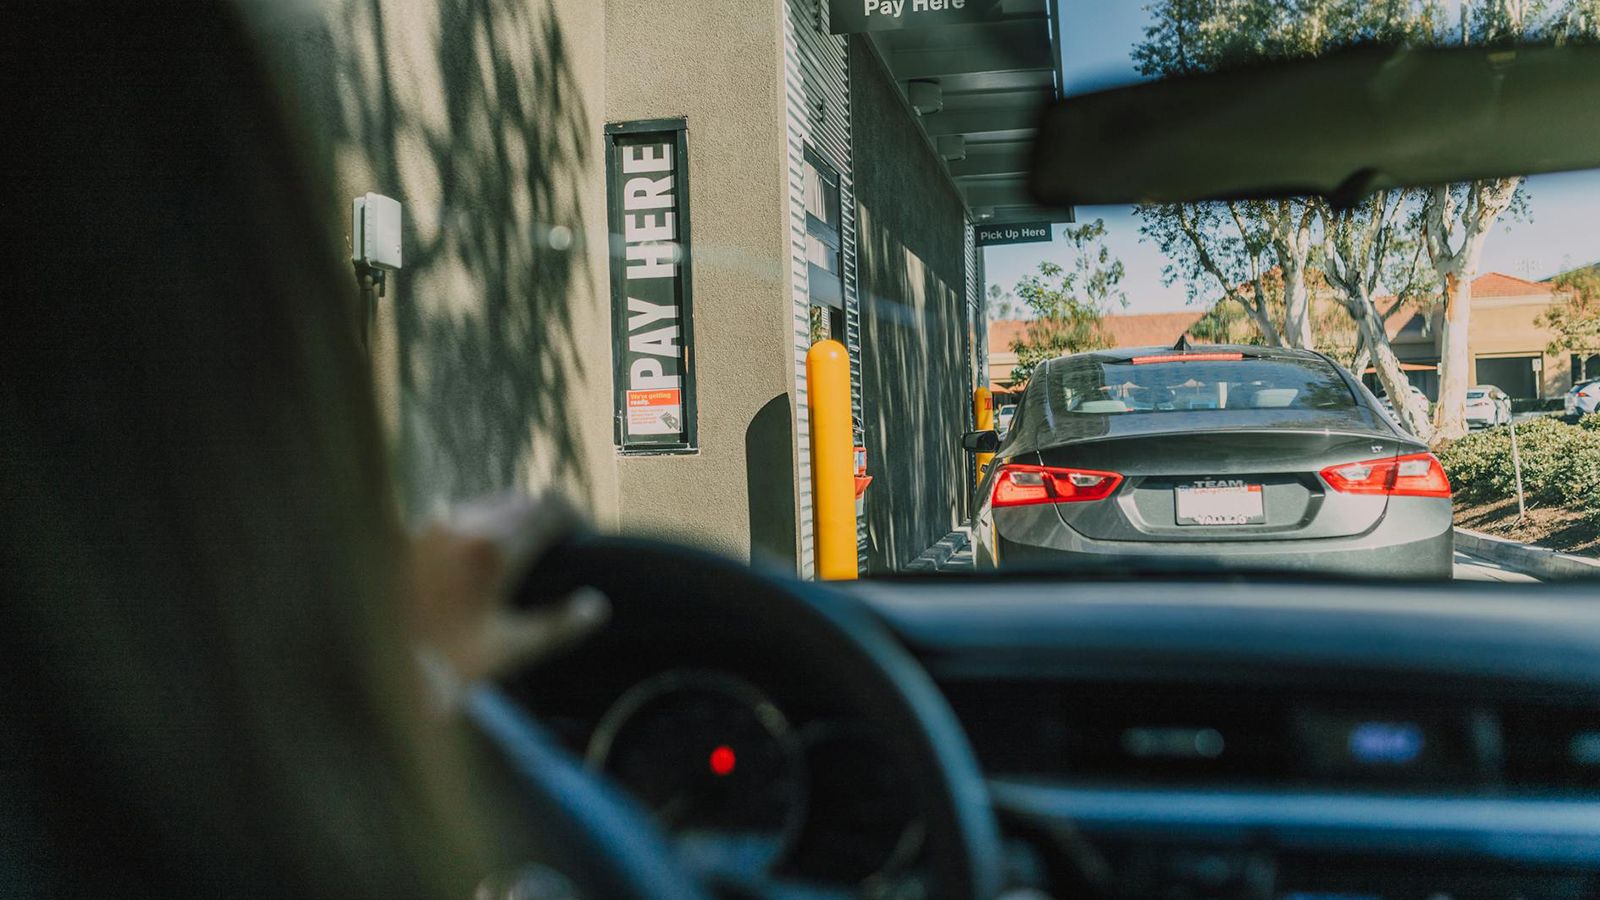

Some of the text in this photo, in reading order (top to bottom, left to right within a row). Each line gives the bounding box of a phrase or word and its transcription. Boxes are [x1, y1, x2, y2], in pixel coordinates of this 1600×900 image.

[864, 0, 965, 18] Pay Here
[623, 144, 677, 279] HERE
[980, 228, 1047, 241] Pick Up Here
[628, 296, 680, 390] PAY
[648, 392, 672, 400] getting
[1194, 480, 1243, 488] TEAM
